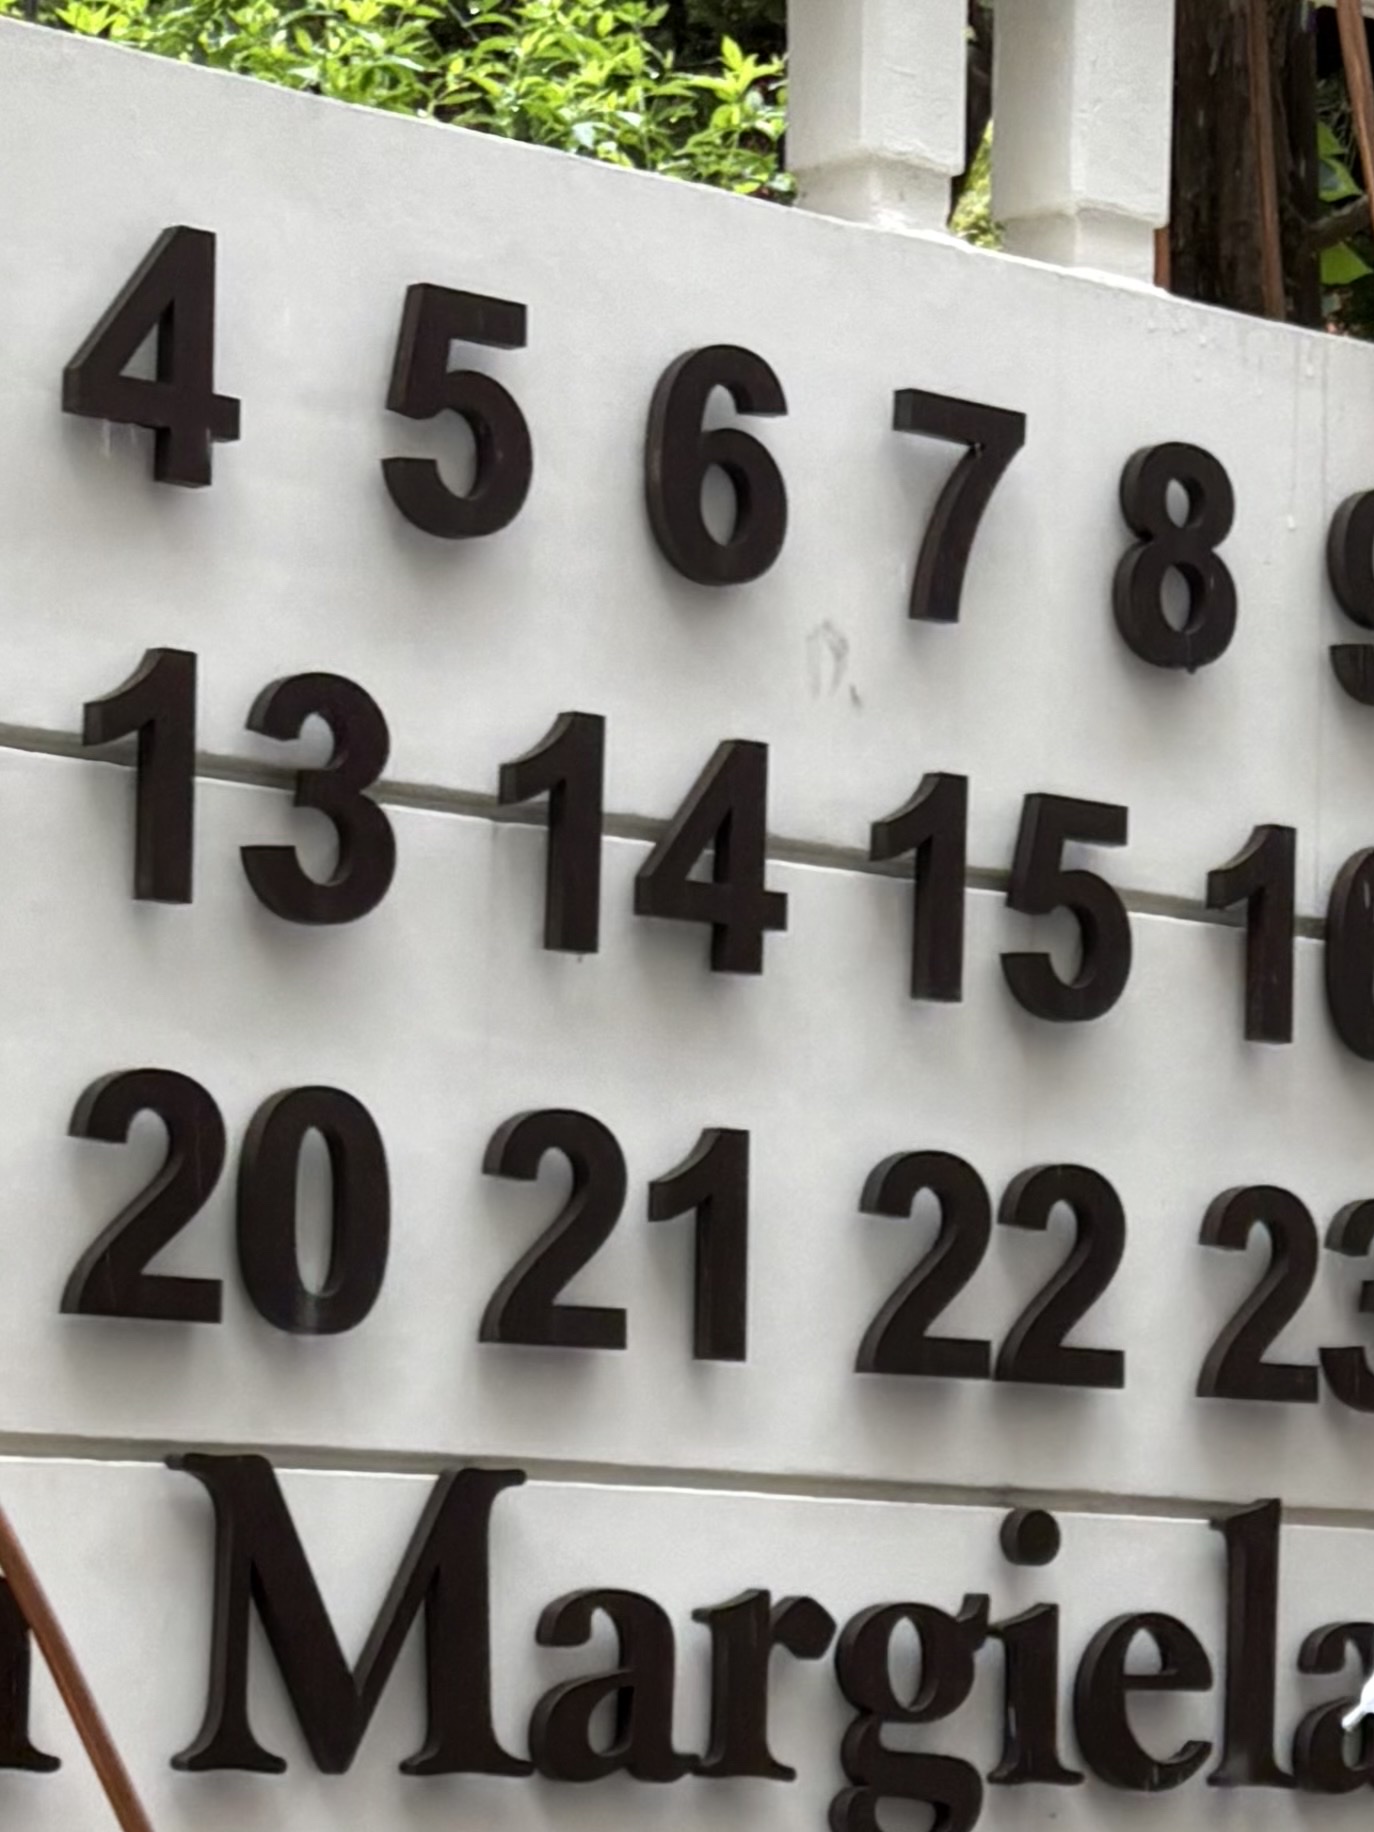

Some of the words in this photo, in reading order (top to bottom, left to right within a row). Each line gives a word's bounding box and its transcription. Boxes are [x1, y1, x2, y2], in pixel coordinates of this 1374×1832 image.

[62, 226, 241, 488] 4
[381, 283, 533, 540] 5
[644, 345, 788, 587] 6
[893, 389, 1027, 623] 7
[1112, 442, 1237, 672] 8
[83, 648, 397, 925] 13
[499, 711, 788, 975] 14
[870, 772, 1133, 1023] 15
[60, 1068, 391, 1336] 20
[478, 1109, 749, 1362] 21
[855, 1150, 1127, 1390] 22
